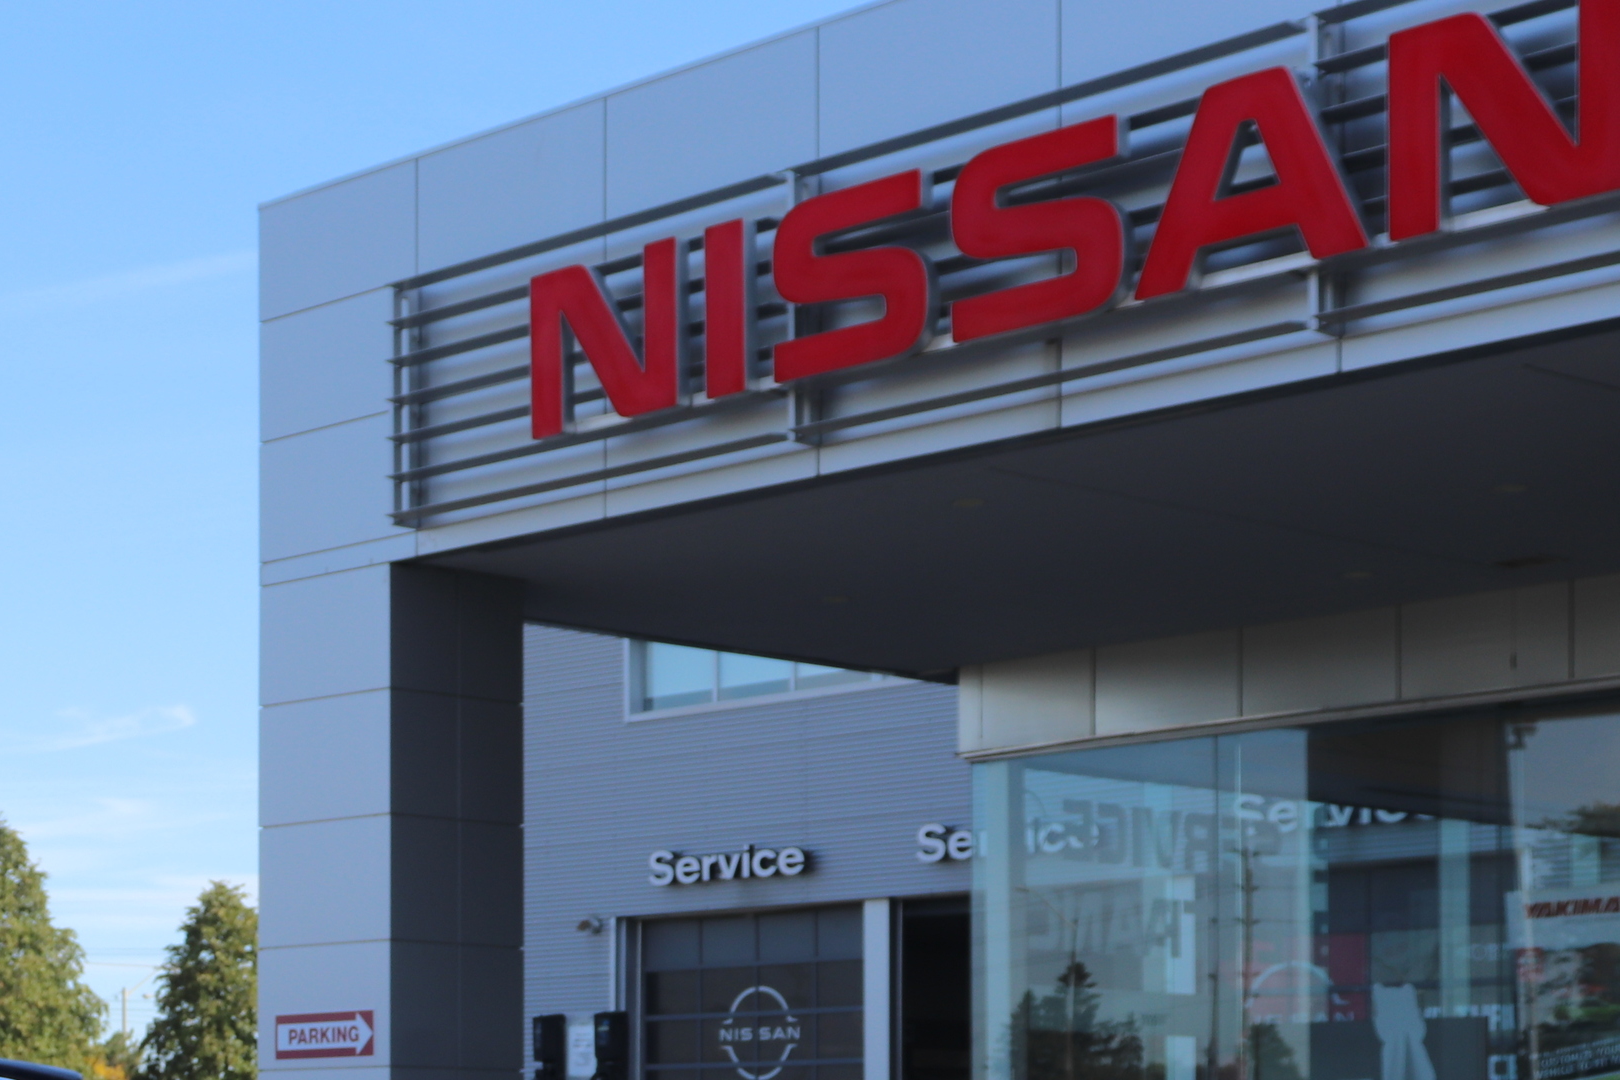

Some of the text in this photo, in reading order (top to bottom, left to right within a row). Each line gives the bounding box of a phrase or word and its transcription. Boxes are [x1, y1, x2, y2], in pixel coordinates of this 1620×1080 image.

[530, 0, 1620, 440] NISSAN
[1235, 794, 1437, 834] Servic
[648, 844, 806, 887] Service
[1525, 897, 1620, 919] YAKIMA
[288, 1026, 359, 1045] PARKING
[719, 1026, 801, 1041] NISSAN
